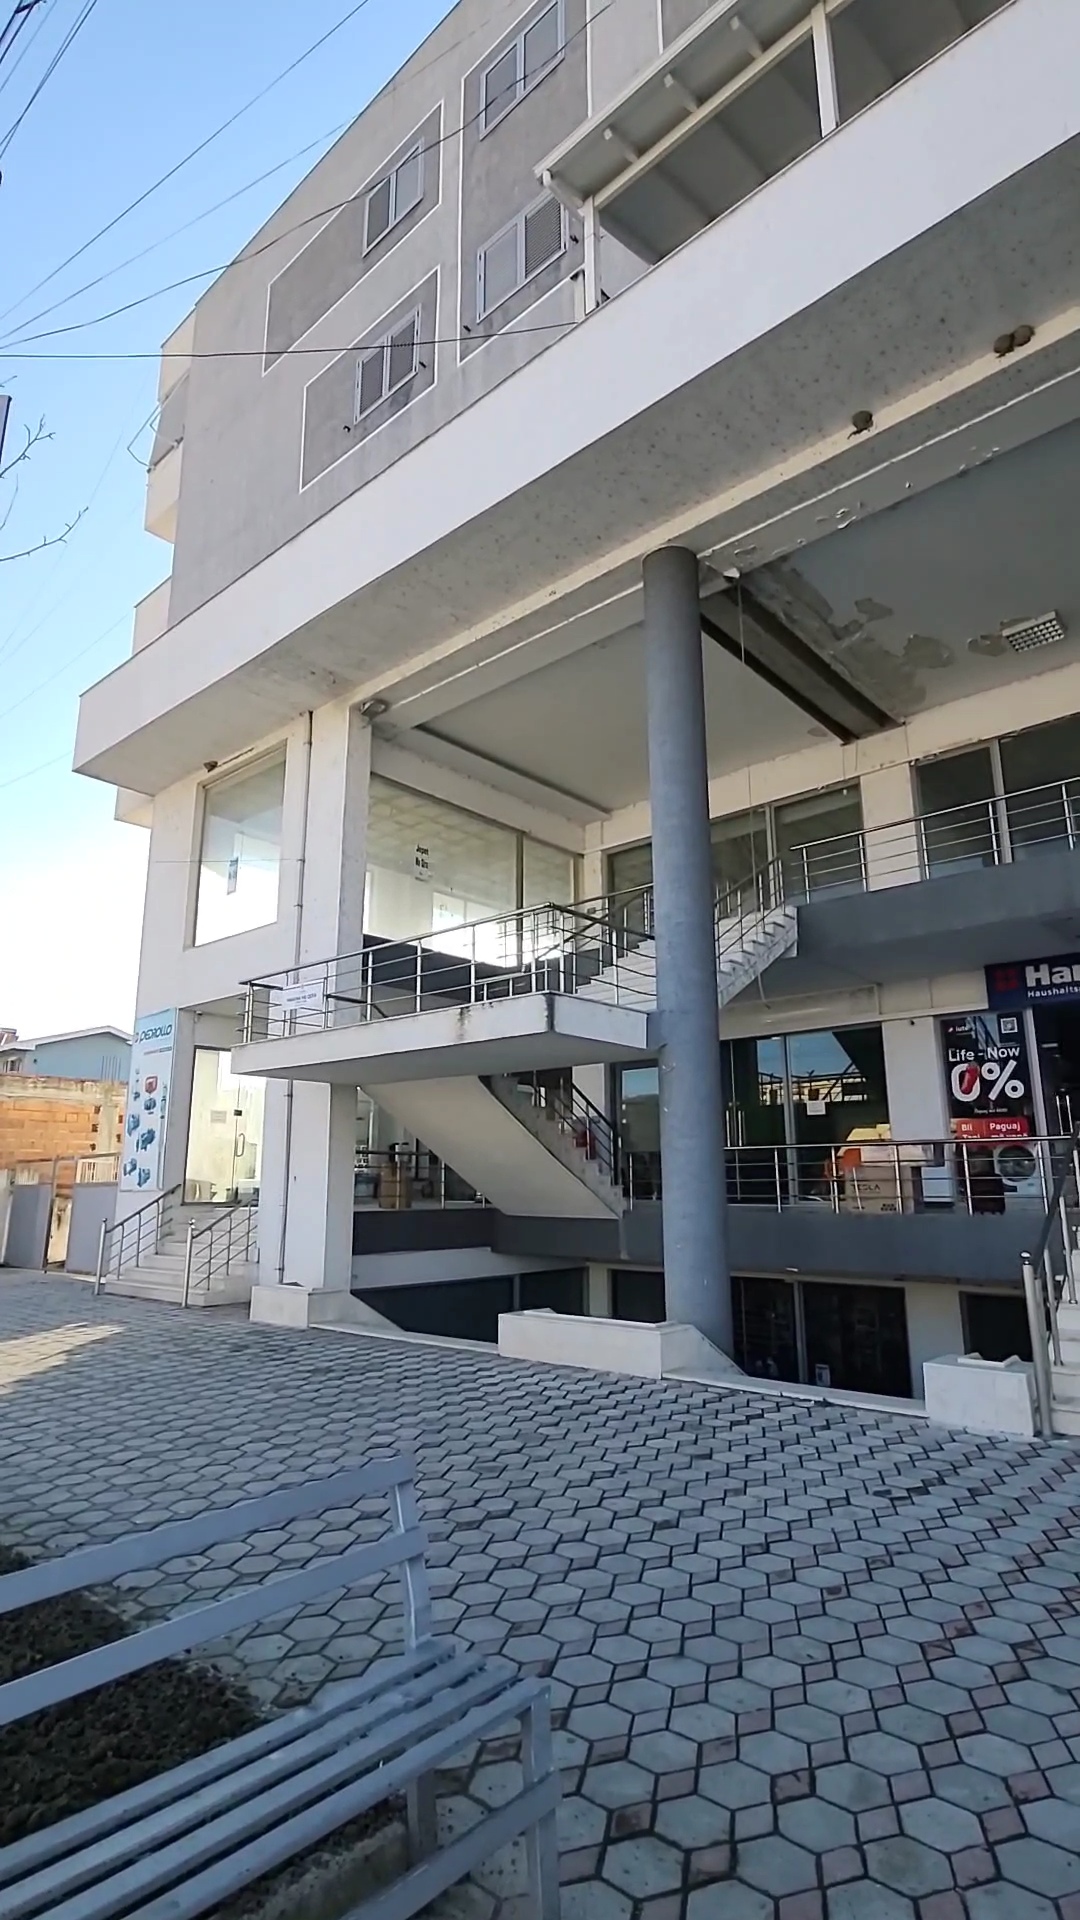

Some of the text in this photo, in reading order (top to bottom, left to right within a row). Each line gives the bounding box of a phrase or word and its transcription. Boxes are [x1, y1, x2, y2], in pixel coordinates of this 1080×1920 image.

[948, 1048, 975, 1062] Life
[987, 1046, 1020, 1060] Now
[989, 1121, 1021, 1131] Paguaj
